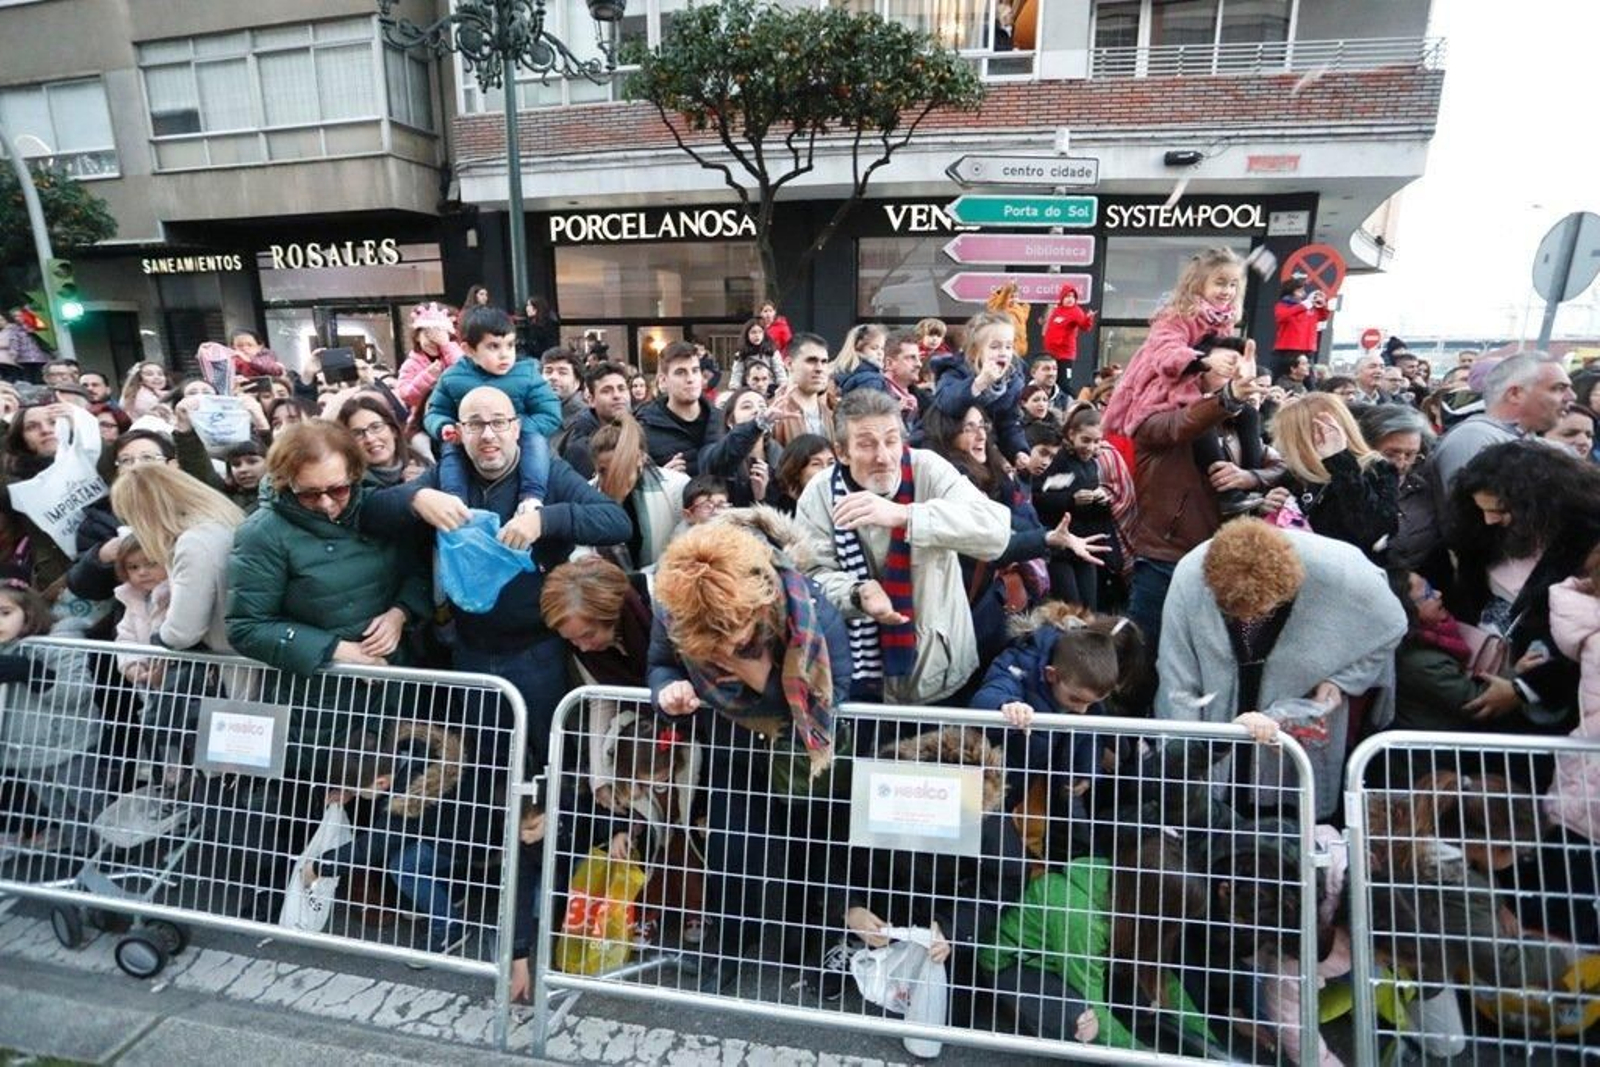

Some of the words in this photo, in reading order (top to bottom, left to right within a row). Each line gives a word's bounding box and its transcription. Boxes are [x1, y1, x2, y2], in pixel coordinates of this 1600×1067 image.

[1002, 165, 1044, 176] centro
[1050, 164, 1092, 178] cidade
[1003, 205, 1038, 217] Porta
[1045, 205, 1061, 217] do
[1068, 205, 1089, 218] Sol
[550, 209, 757, 242] PORCELANOSA
[270, 238, 400, 270] ROSALES
[1025, 245, 1086, 256] biblioteca
[141, 254, 242, 275] SANEAMIENTOS
